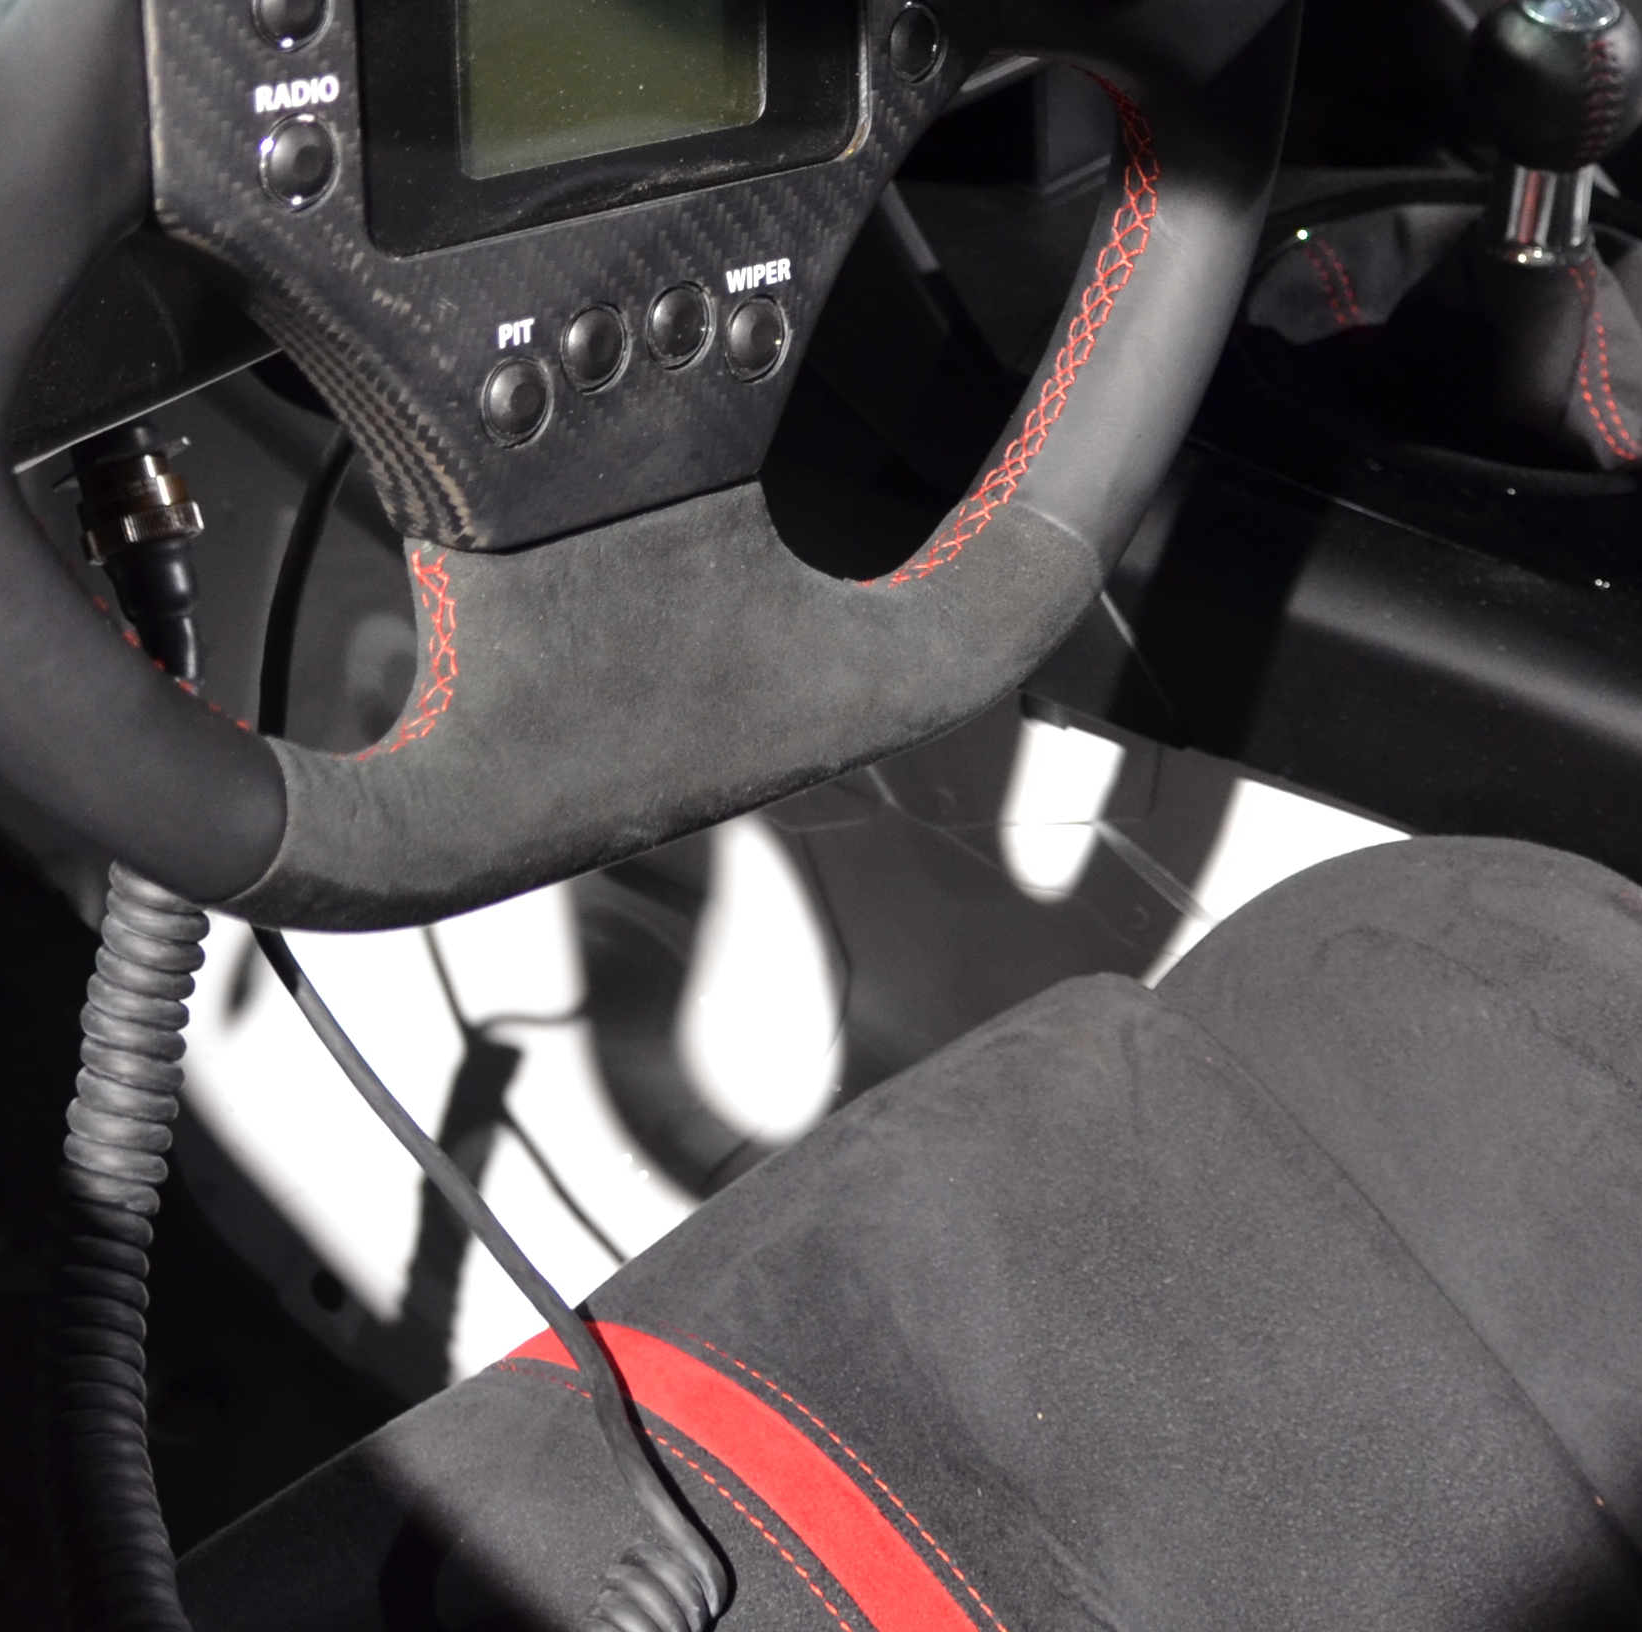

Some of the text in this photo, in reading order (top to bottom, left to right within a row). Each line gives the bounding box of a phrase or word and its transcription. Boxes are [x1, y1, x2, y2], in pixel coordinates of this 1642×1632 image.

[255, 75, 340, 113] RADIO
[725, 258, 792, 294] WIPER
[498, 318, 536, 350] PIT
